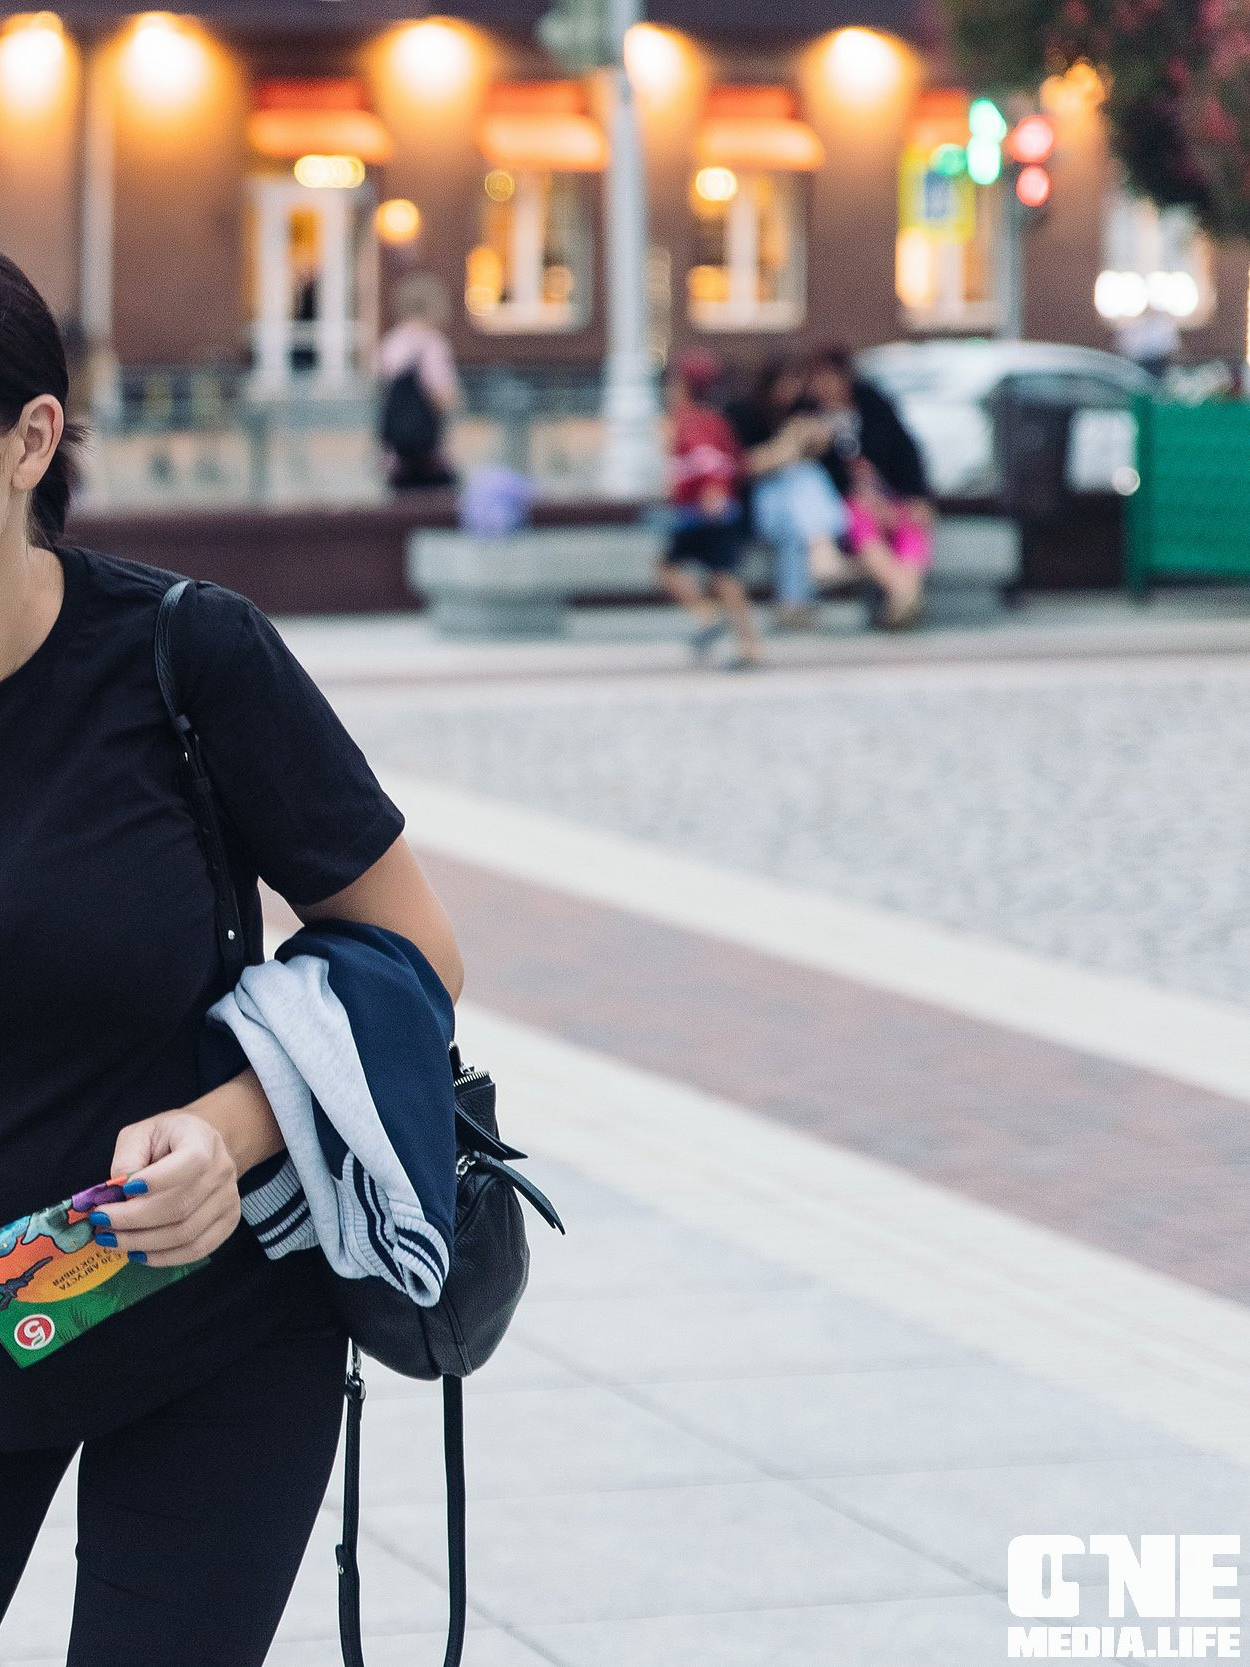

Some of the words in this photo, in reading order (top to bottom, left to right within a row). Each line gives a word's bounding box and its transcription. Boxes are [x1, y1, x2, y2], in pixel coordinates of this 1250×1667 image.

[52, 1256, 95, 1287] ОКТЯБРЯ
[59, 1262, 99, 1291] АВГУСТА
[24, 1319, 46, 1347] 5
